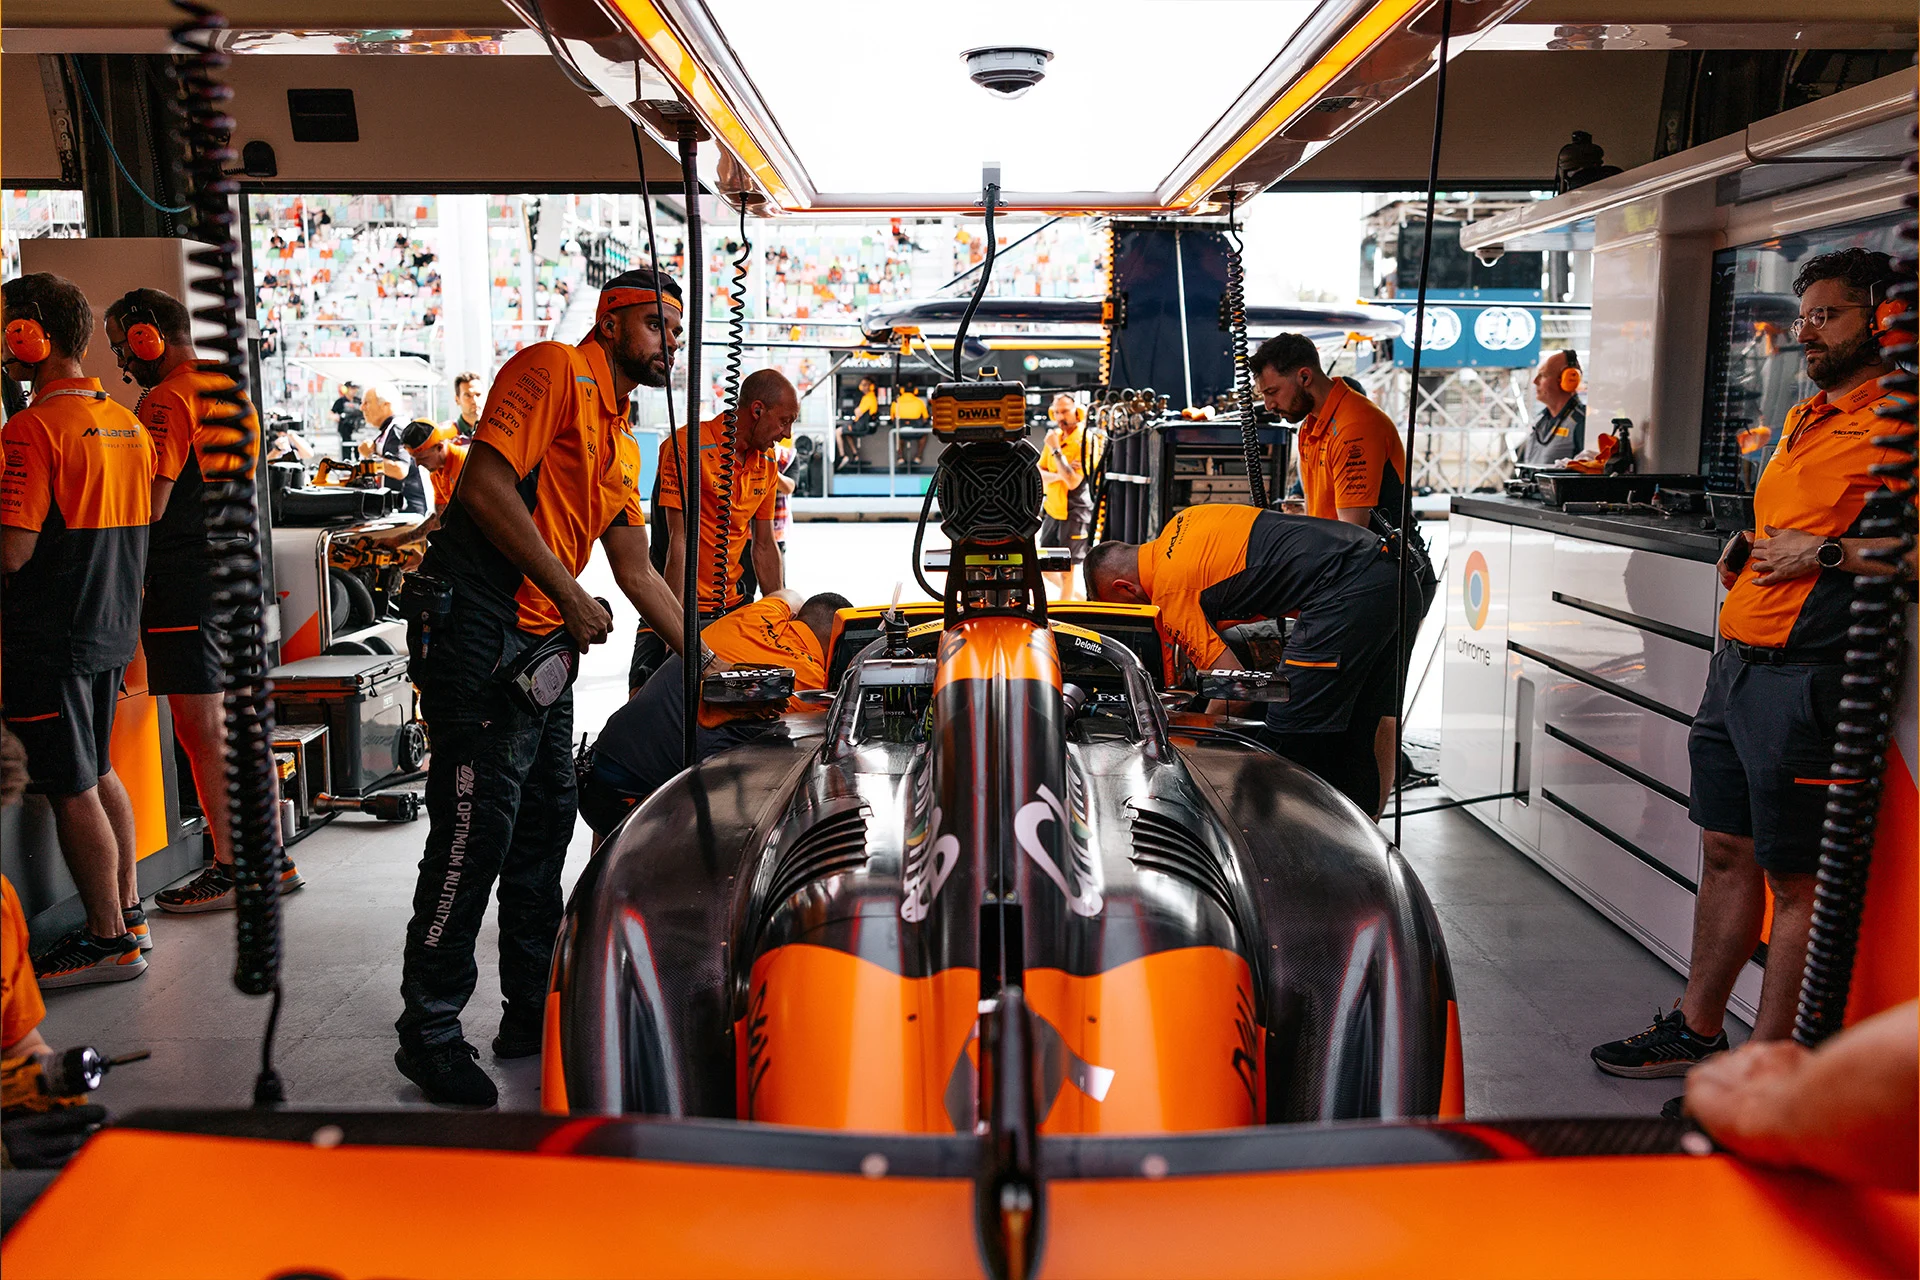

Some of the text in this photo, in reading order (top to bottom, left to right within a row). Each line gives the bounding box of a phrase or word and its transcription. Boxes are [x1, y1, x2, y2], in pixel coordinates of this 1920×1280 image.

[521, 375, 544, 394] Hilton
[507, 389, 534, 411] alteryx
[494, 406, 520, 429] FxPro
[81, 425, 139, 438] McLaren
[1457, 634, 1491, 666] chrome
[449, 801, 472, 867] OPTIMUM
[424, 869, 461, 948] NUTRITION
